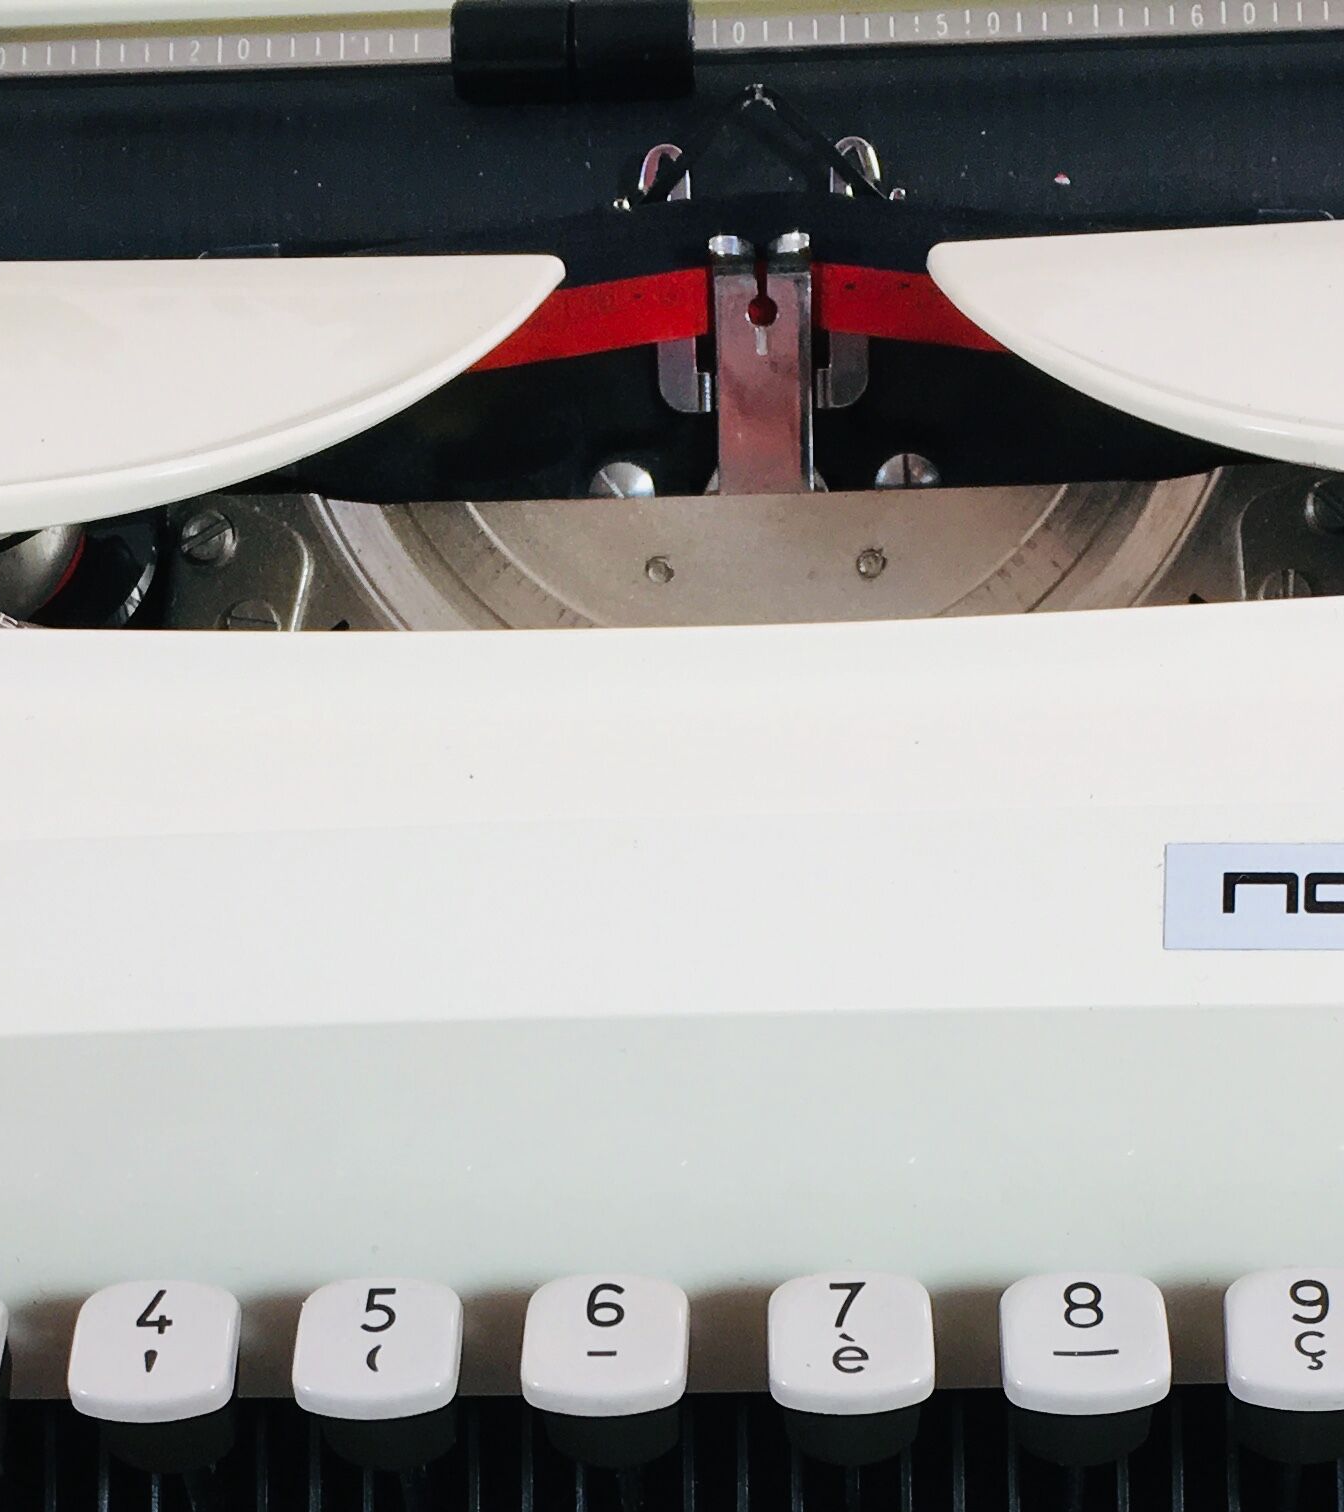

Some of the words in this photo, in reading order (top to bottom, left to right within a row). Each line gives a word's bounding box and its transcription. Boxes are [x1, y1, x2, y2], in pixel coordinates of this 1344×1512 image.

[134, 1288, 174, 1336] 4
[359, 1286, 398, 1334] 5
[585, 1281, 626, 1329] 6
[827, 1280, 868, 1330] 7
[1062, 1280, 1105, 1330] 8
[1288, 1278, 1331, 1326] 9
[831, 1331, 871, 1375] è
[1293, 1329, 1328, 1372] ç
